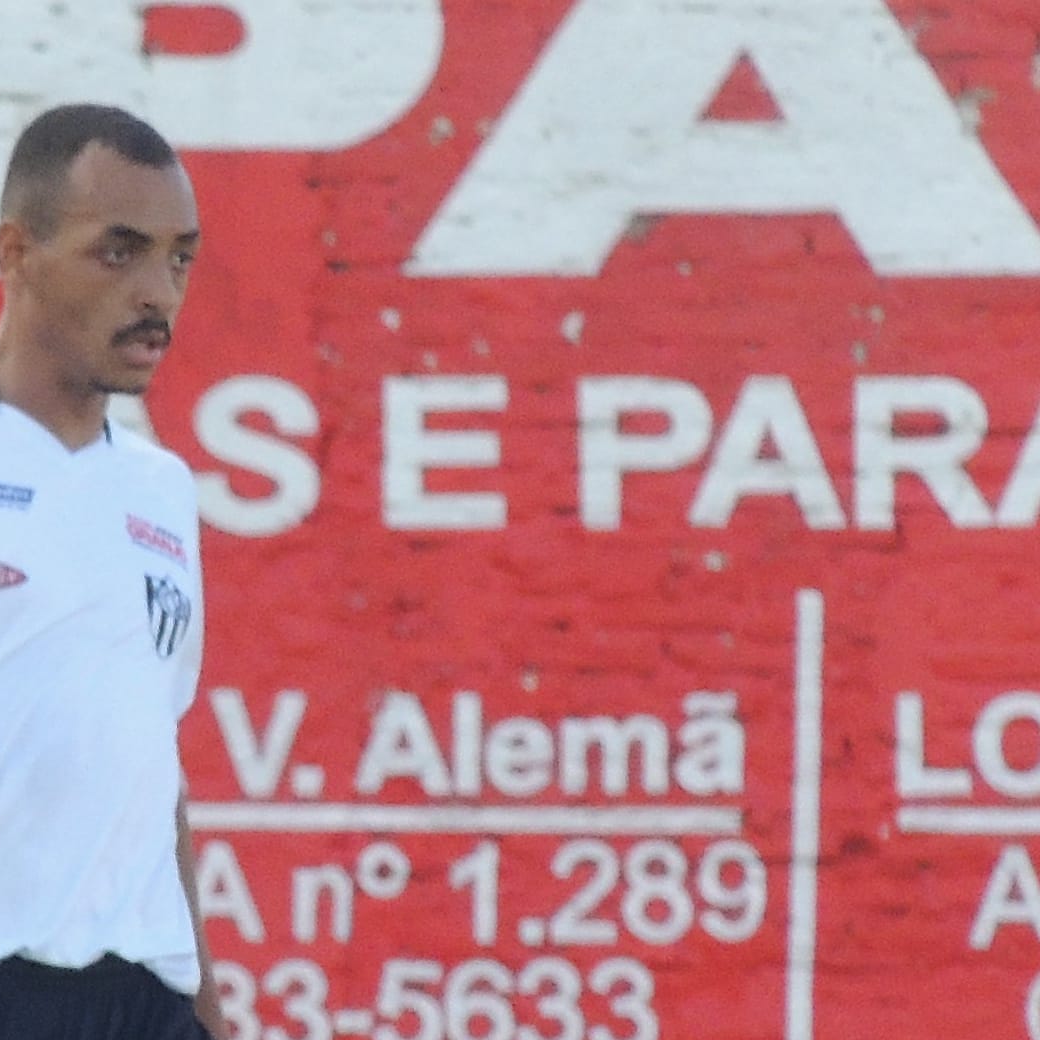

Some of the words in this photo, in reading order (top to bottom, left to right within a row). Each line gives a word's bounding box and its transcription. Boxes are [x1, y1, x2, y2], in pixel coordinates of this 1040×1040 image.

[380, 374, 510, 531] E
[210, 687, 324, 799] V.
[354, 691, 746, 797] Alemã
[197, 840, 265, 943] A
[450, 838, 767, 946] 1.289
